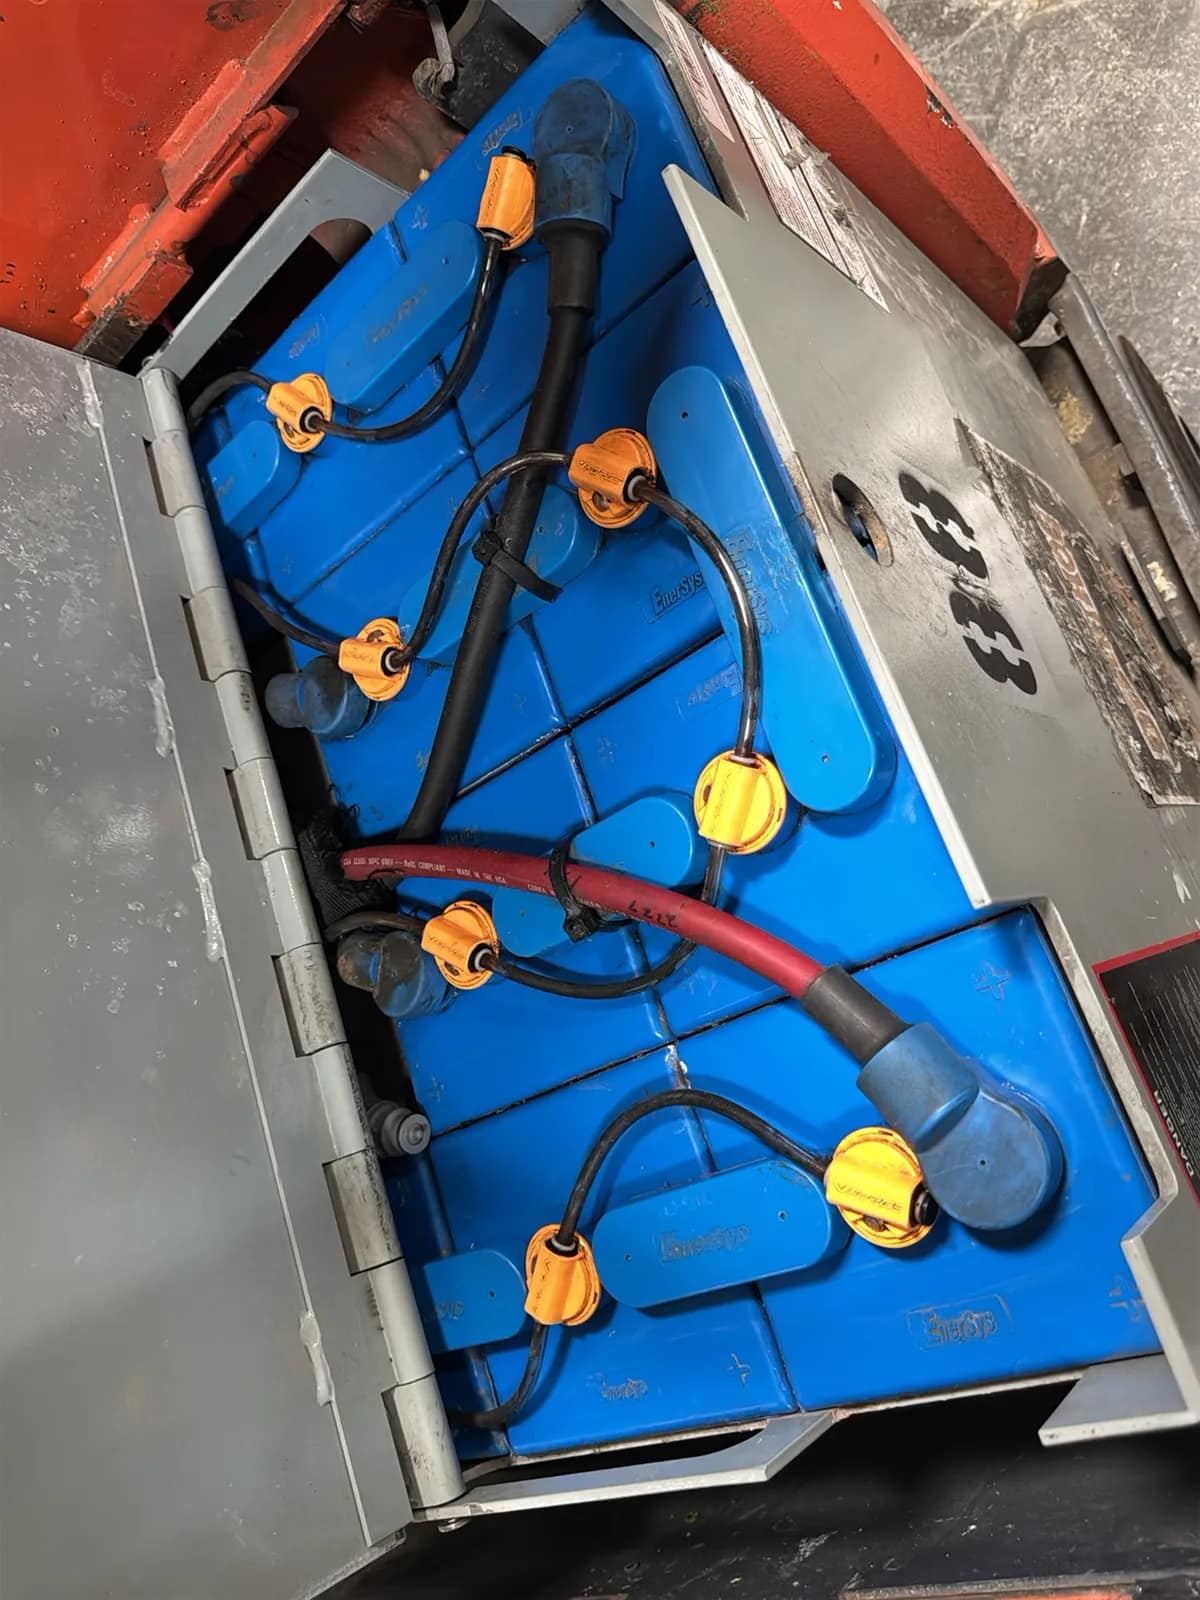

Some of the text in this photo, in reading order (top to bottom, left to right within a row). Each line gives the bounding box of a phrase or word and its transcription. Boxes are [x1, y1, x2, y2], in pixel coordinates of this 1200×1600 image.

[654, 570, 703, 616] EnerSys
[418, 861, 446, 873] COMPLIANT
[1153, 1089, 1196, 1178] DANGER
